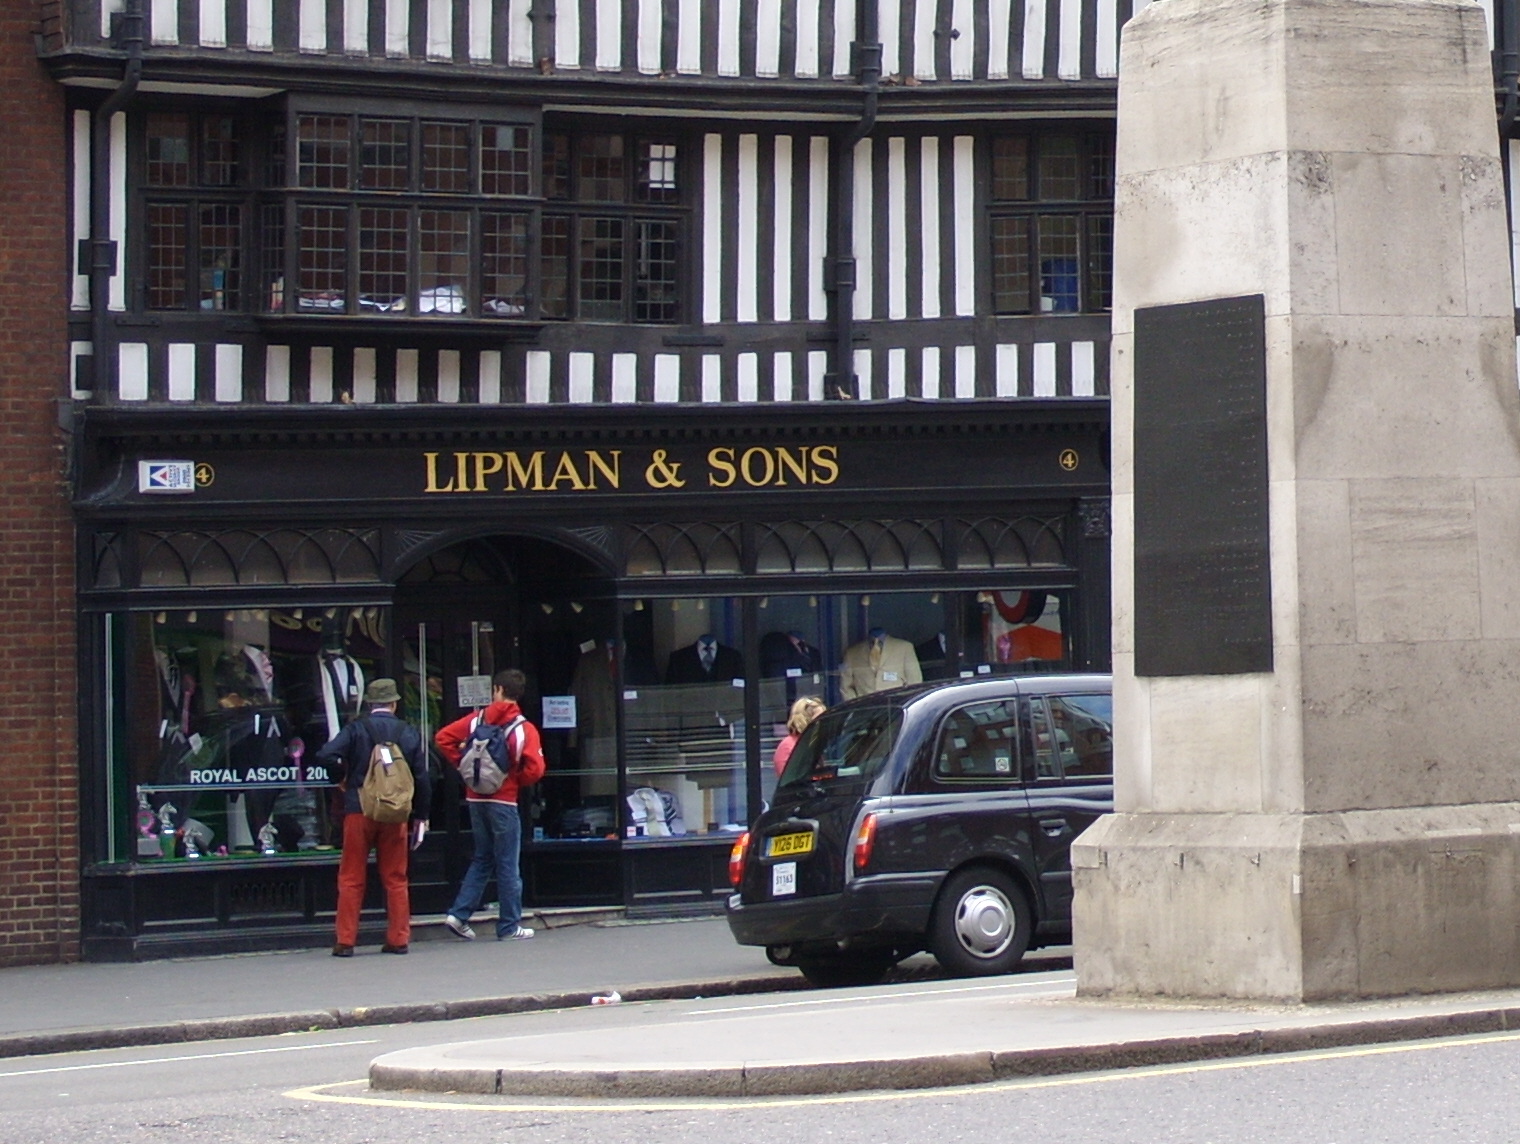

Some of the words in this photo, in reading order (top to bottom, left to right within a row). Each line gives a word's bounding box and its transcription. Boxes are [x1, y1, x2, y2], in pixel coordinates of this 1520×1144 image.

[423, 450, 622, 492] LIPMAN
[645, 449, 686, 489] &
[707, 445, 840, 487] SONS
[1062, 452, 1075, 468] 4
[195, 466, 210, 483] 4
[190, 769, 243, 784] ROYAL
[245, 766, 299, 782] ASCOT
